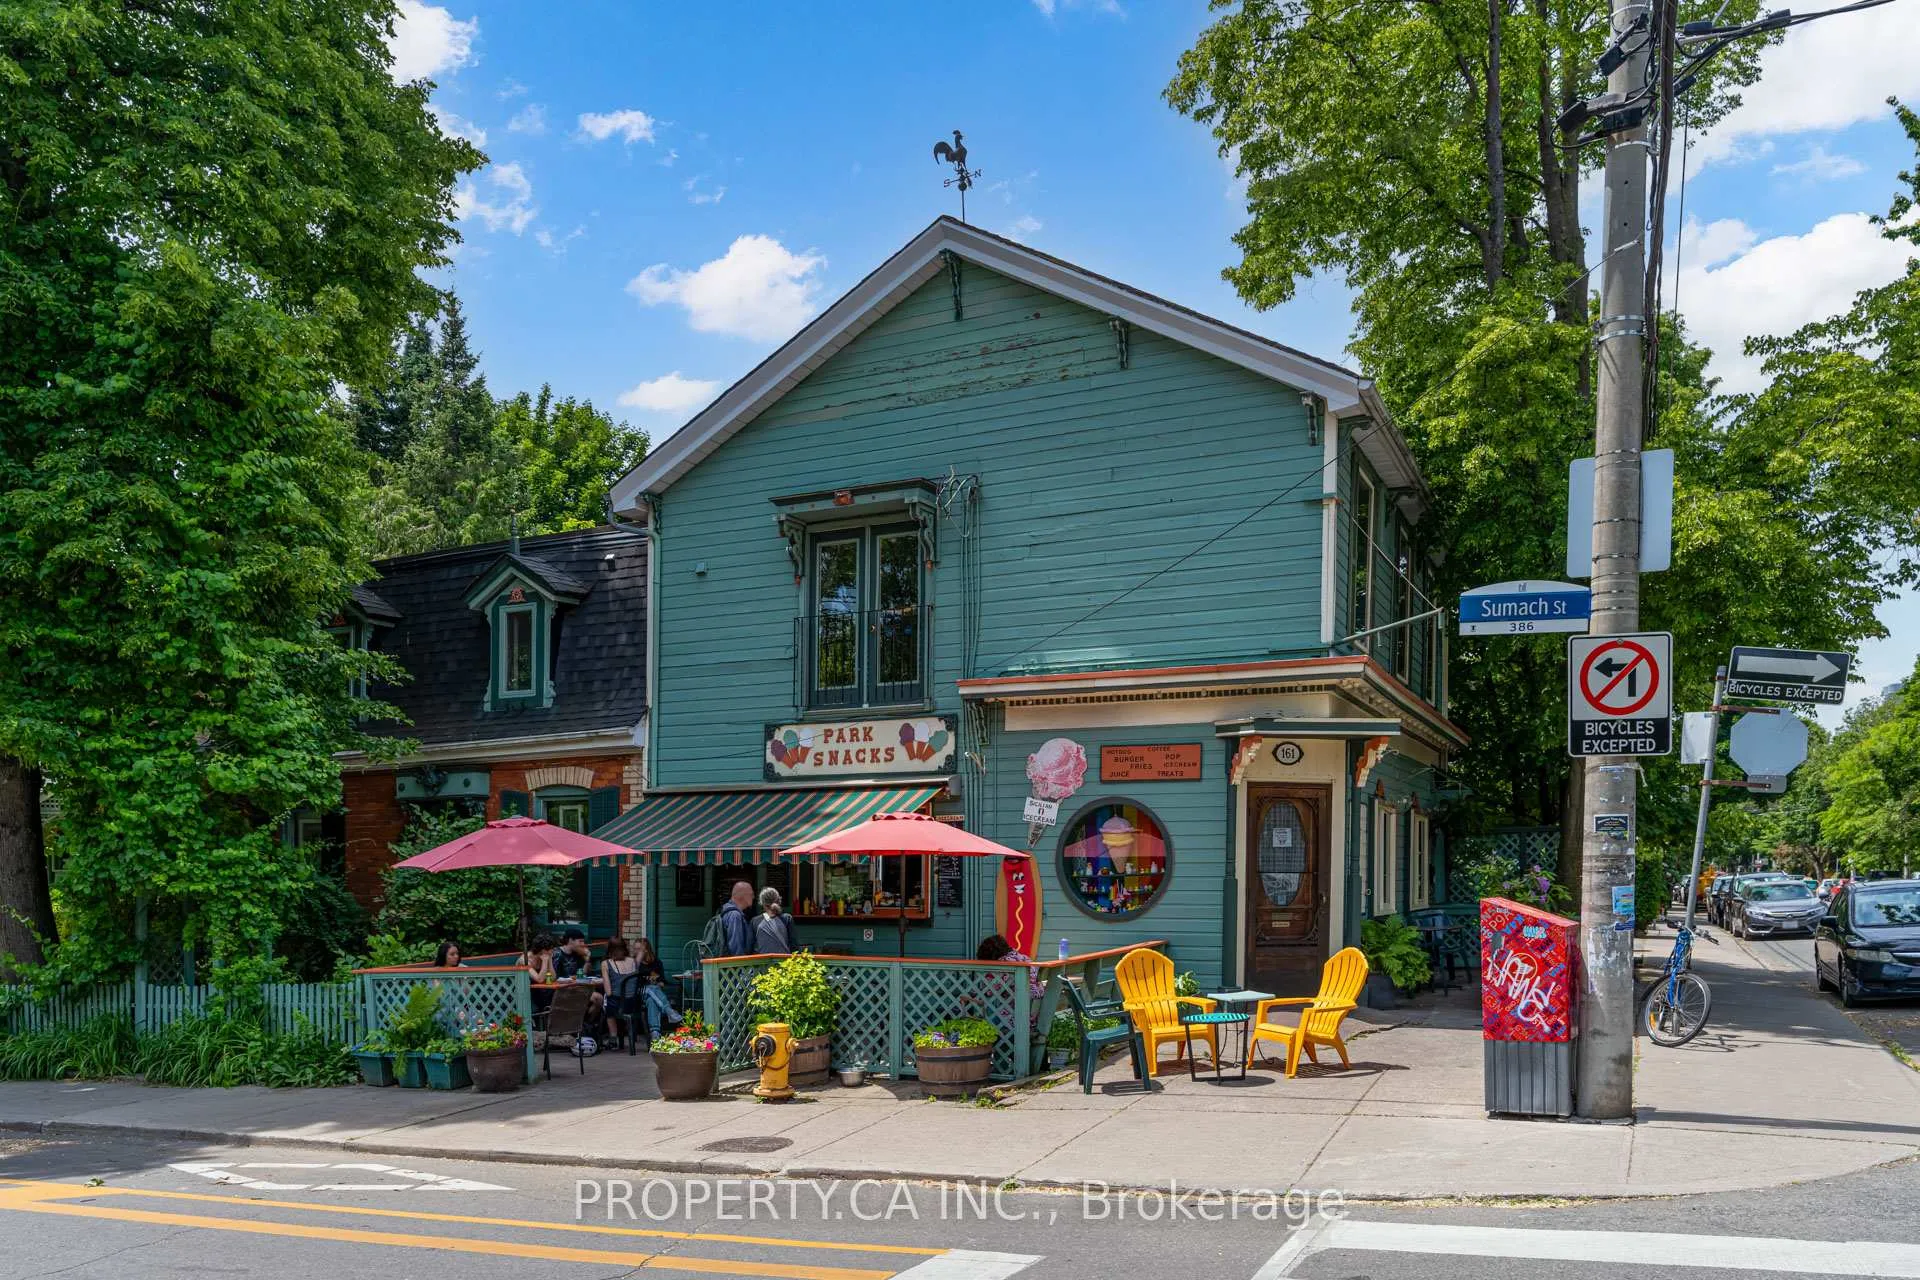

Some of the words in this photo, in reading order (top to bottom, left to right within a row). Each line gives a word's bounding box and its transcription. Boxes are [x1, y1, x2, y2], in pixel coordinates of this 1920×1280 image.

[1481, 597, 1548, 617] Sumach
[1553, 600, 1567, 615] St
[1509, 622, 1534, 632] 386
[1729, 683, 1781, 697] BICYCLES
[1785, 686, 1843, 701] EXCEPTED
[823, 726, 873, 744] PARK
[1585, 721, 1655, 736] BICYCLES
[1282, 747, 1295, 759] 161
[1582, 739, 1656, 753] EXCEPTED
[813, 746, 895, 767] SNACKS
[1109, 770, 1129, 778] JUICE
